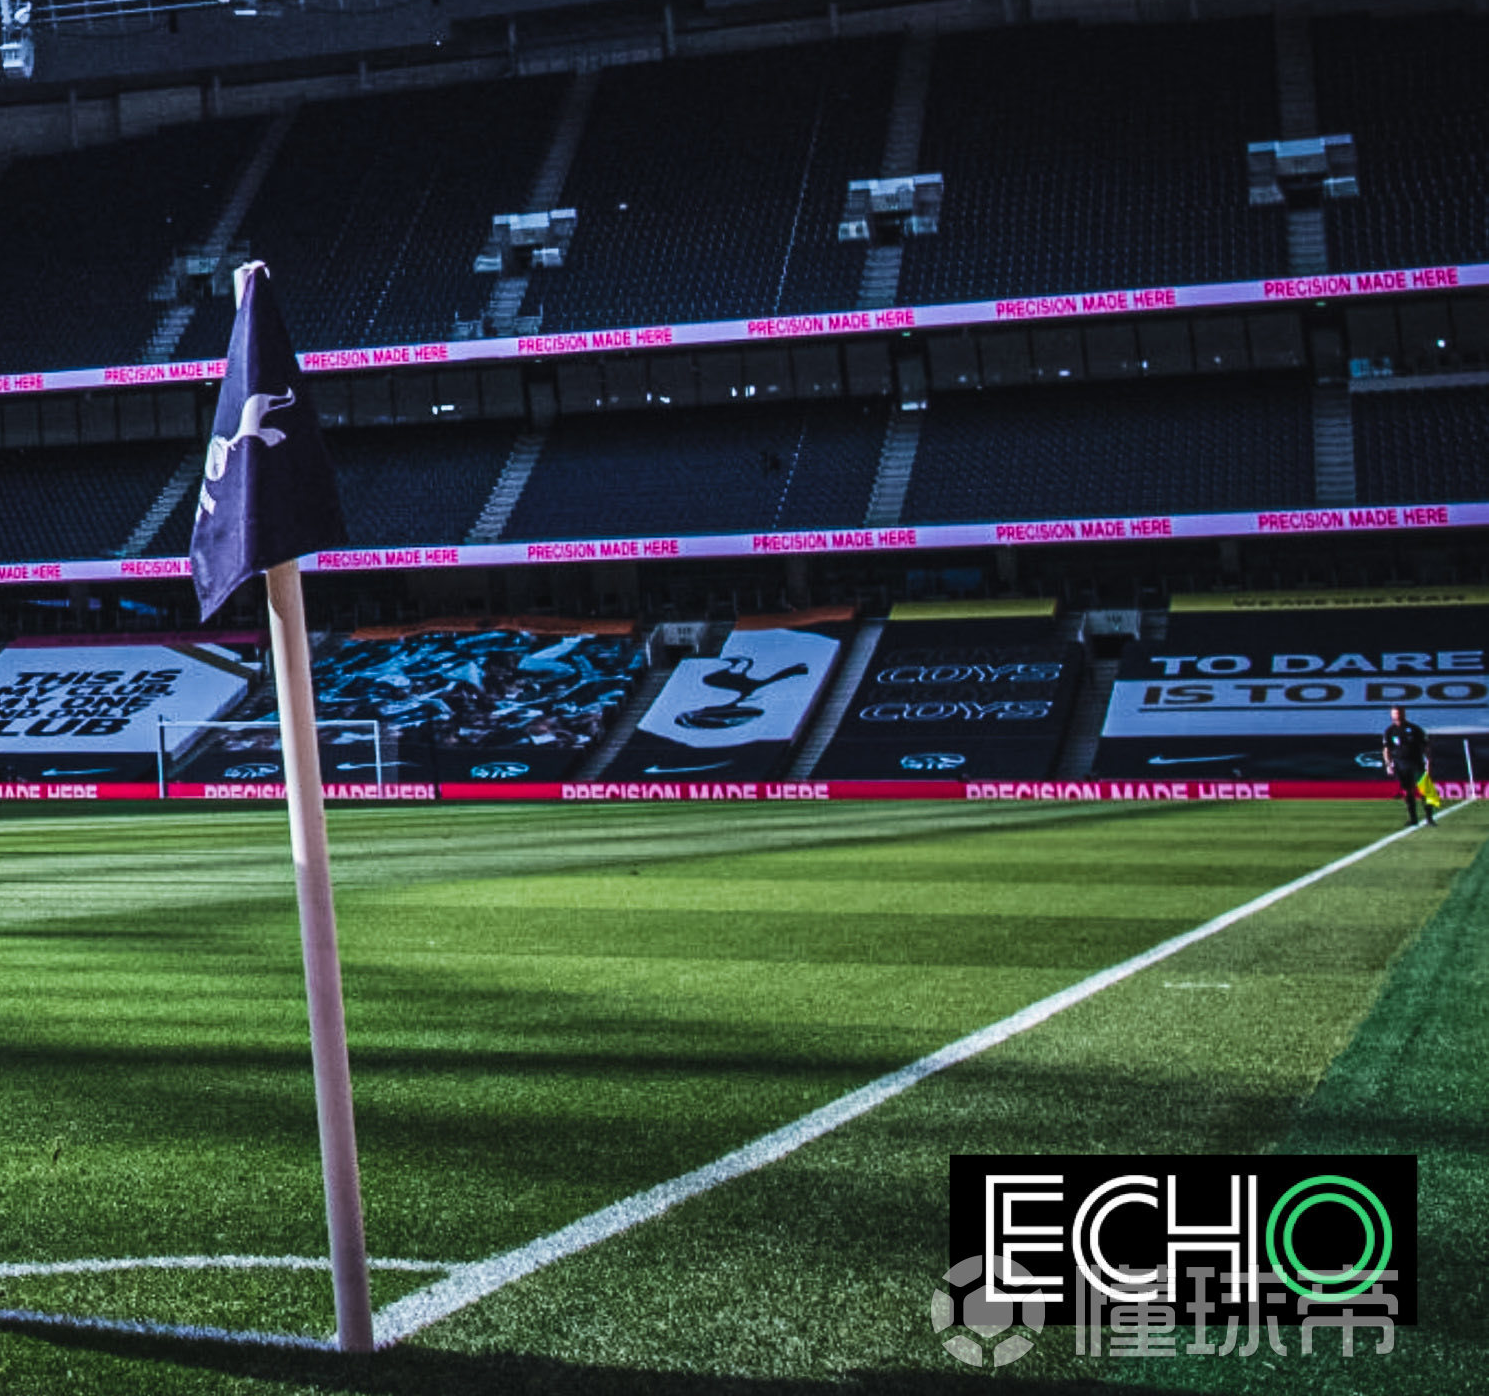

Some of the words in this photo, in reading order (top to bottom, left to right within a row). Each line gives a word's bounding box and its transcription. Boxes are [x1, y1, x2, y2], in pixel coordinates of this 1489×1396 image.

[1264, 277, 1350, 298] PRECISION
[1357, 272, 1405, 293] MADE
[1412, 268, 1457, 288] HERE
[996, 298, 1076, 319] PRECISION
[1083, 293, 1126, 313] MADE
[1133, 289, 1175, 309] HERE
[748, 318, 823, 338] PRECISION
[829, 314, 869, 332] MADE
[876, 310, 914, 328] HERE
[519, 336, 587, 355] PRECISION
[593, 332, 630, 348] MADE
[636, 328, 671, 347] HERE
[305, 352, 368, 370] PRECISION
[374, 348, 408, 365] MADE
[415, 346, 447, 361] HERE
[15, 375, 43, 391] HERE
[105, 367, 164, 385] PRECISION
[170, 364, 201, 380] MADE
[996, 524, 1075, 543] PRECISION
[1081, 521, 1124, 539] MADE
[1130, 519, 1171, 537] HERE
[1258, 512, 1343, 532] PRECISION
[1349, 509, 1396, 528] MADE
[1403, 507, 1447, 527] HERE
[528, 544, 595, 561] PRECISION
[600, 542, 637, 556] MADE
[643, 540, 678, 557] HERE
[753, 535, 827, 553] PRECISION
[833, 532, 872, 549] MADE
[878, 530, 915, 548] HERE
[318, 553, 380, 570] PRECISION
[386, 551, 419, 566] MADE
[425, 549, 457, 565] HERE
[32, 565, 60, 580] HERE
[1151, 656, 1251, 675] TO
[1272, 651, 1484, 673] DARE
[15, 671, 125, 685] THIS
[129, 669, 182, 684] IS
[61, 696, 156, 709] ONE
[1143, 685, 1214, 705] IS
[1234, 683, 1344, 703] TO
[1365, 681, 1488, 702] DO
[48, 708, 148, 718] ONLY
